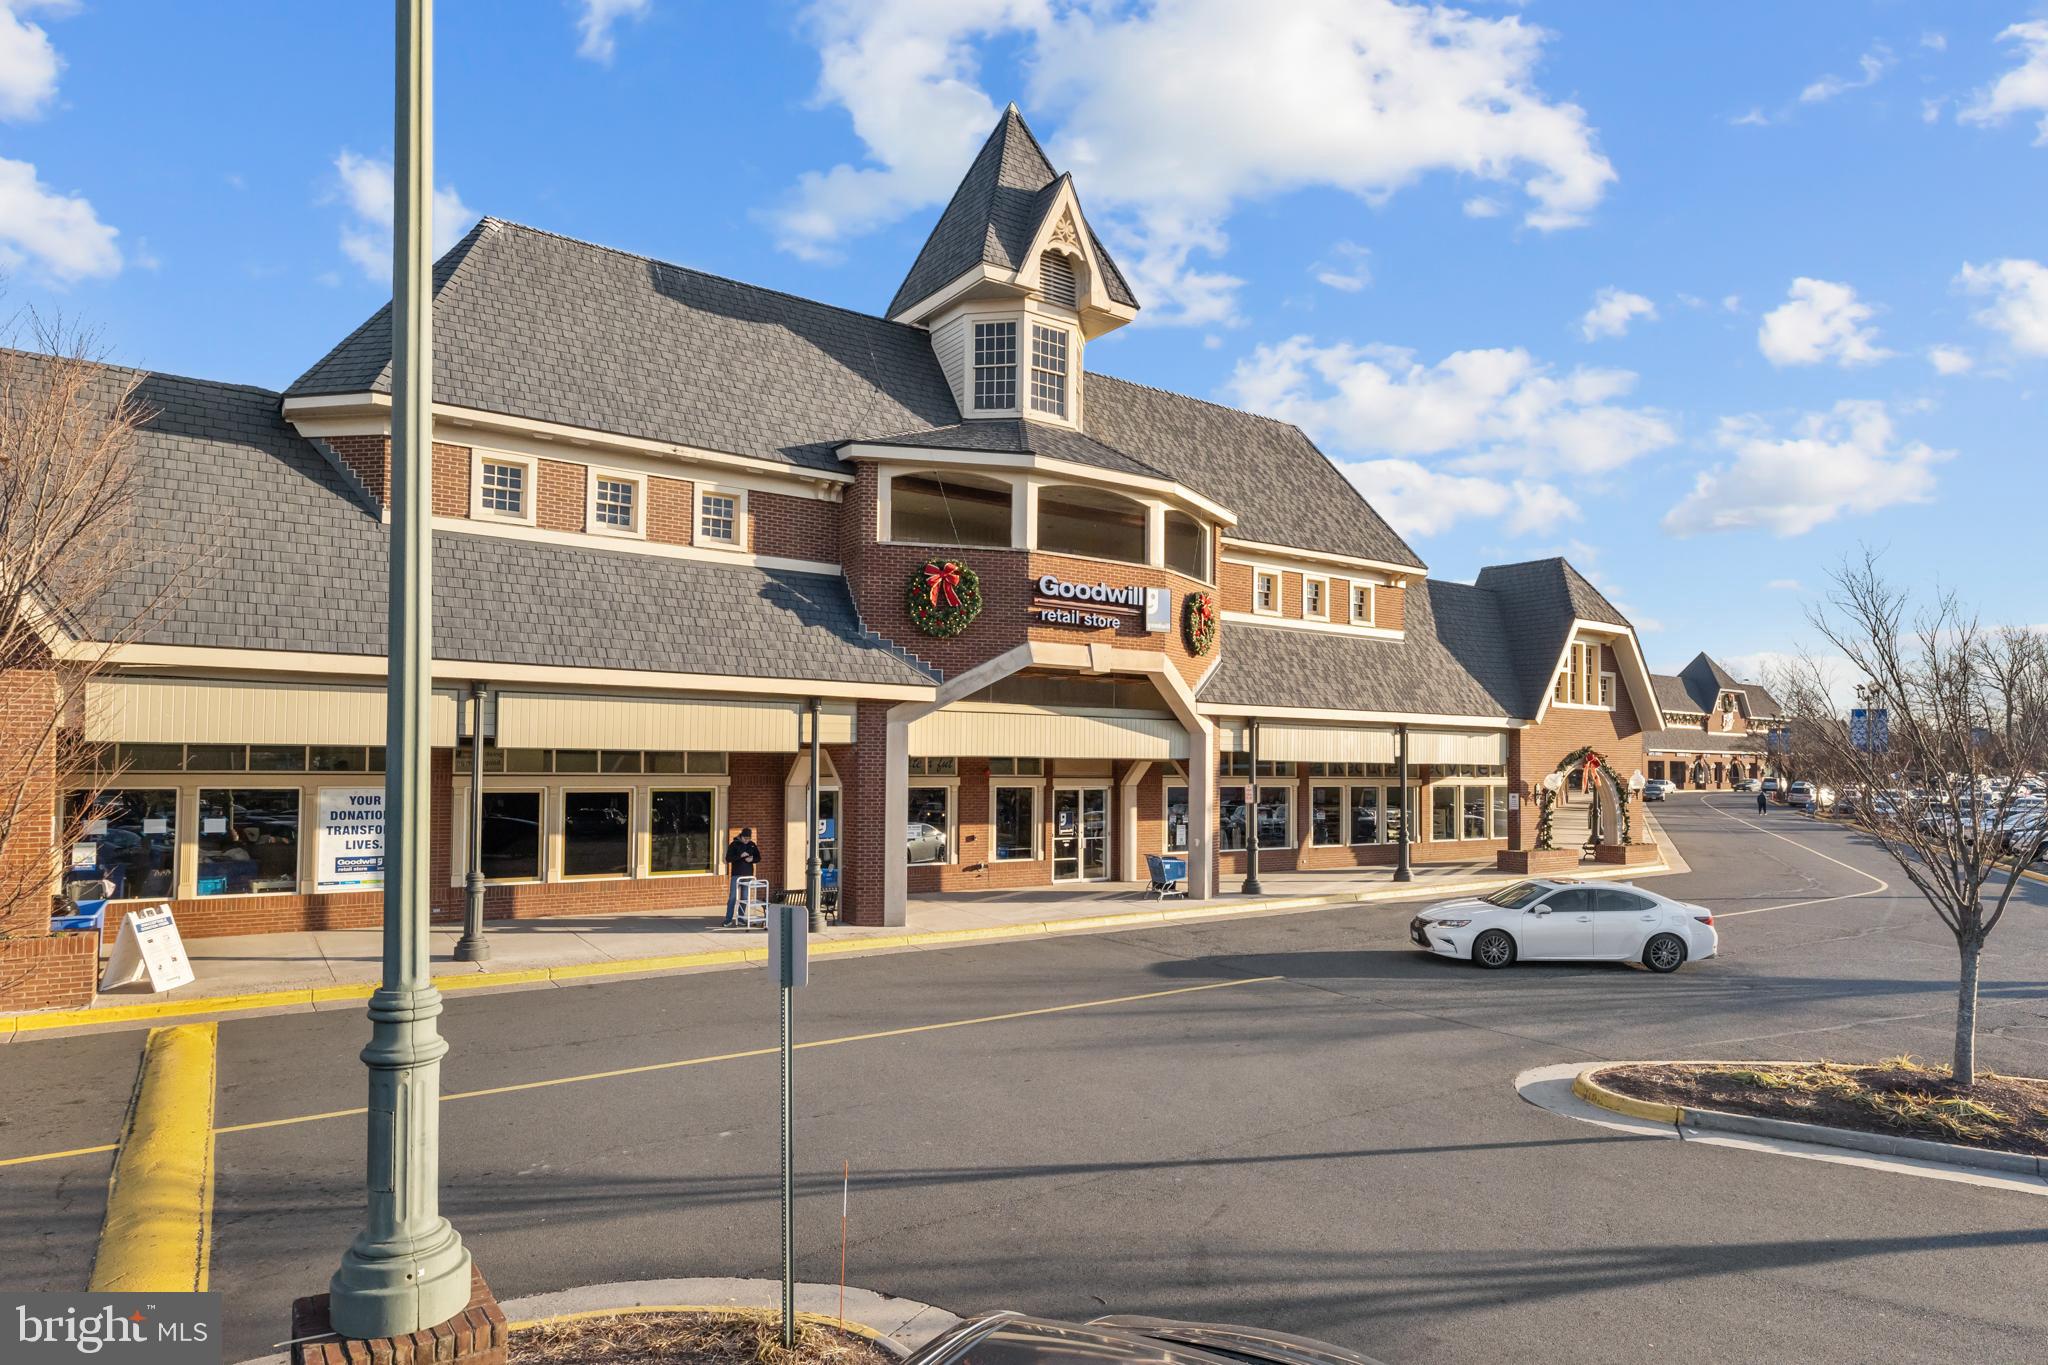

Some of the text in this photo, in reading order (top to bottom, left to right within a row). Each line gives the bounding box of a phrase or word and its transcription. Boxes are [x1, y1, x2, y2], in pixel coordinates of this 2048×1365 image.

[1039, 575, 1143, 606] Goodwill
[1041, 608, 1121, 629] retail store
[350, 796, 381, 806] YOUR
[330, 811, 384, 820] DONATIO
[326, 826, 384, 835] TRANSFO
[345, 840, 382, 849] LIVES.
[337, 858, 376, 866] Goodwill
